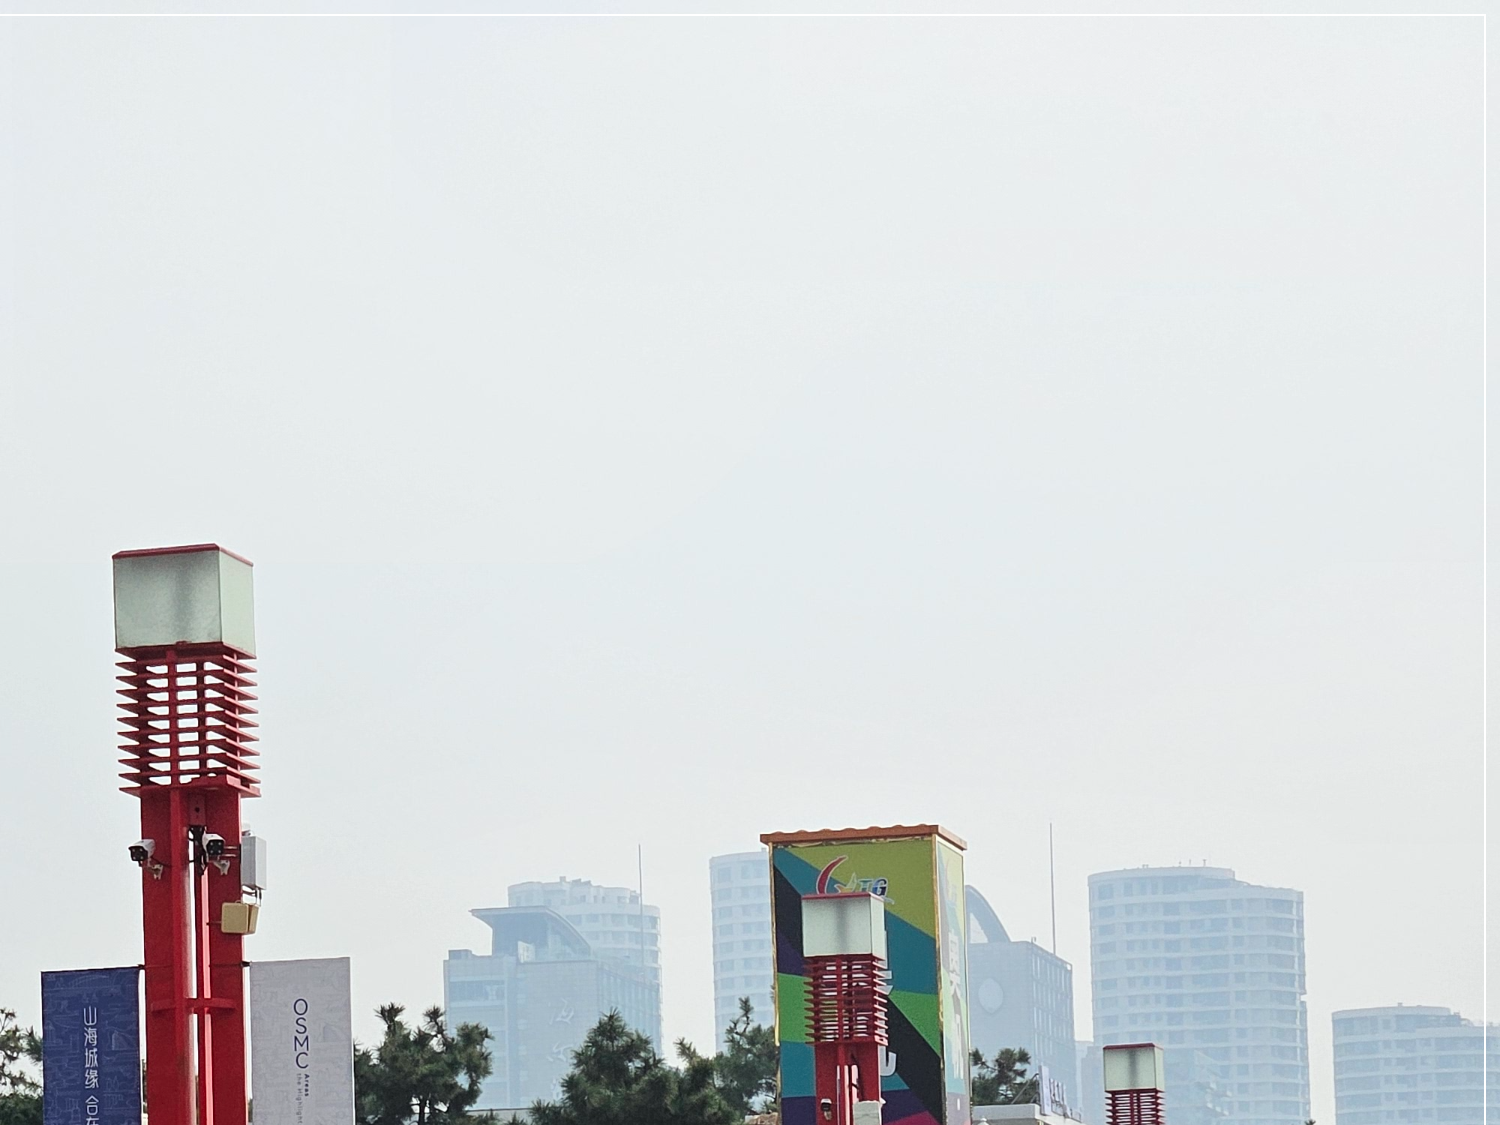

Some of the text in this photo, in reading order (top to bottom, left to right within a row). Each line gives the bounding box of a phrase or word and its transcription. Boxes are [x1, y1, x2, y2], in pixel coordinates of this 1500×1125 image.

[83, 1005, 99, 1089] 山海城缘
[293, 998, 309, 1069] OSMC
